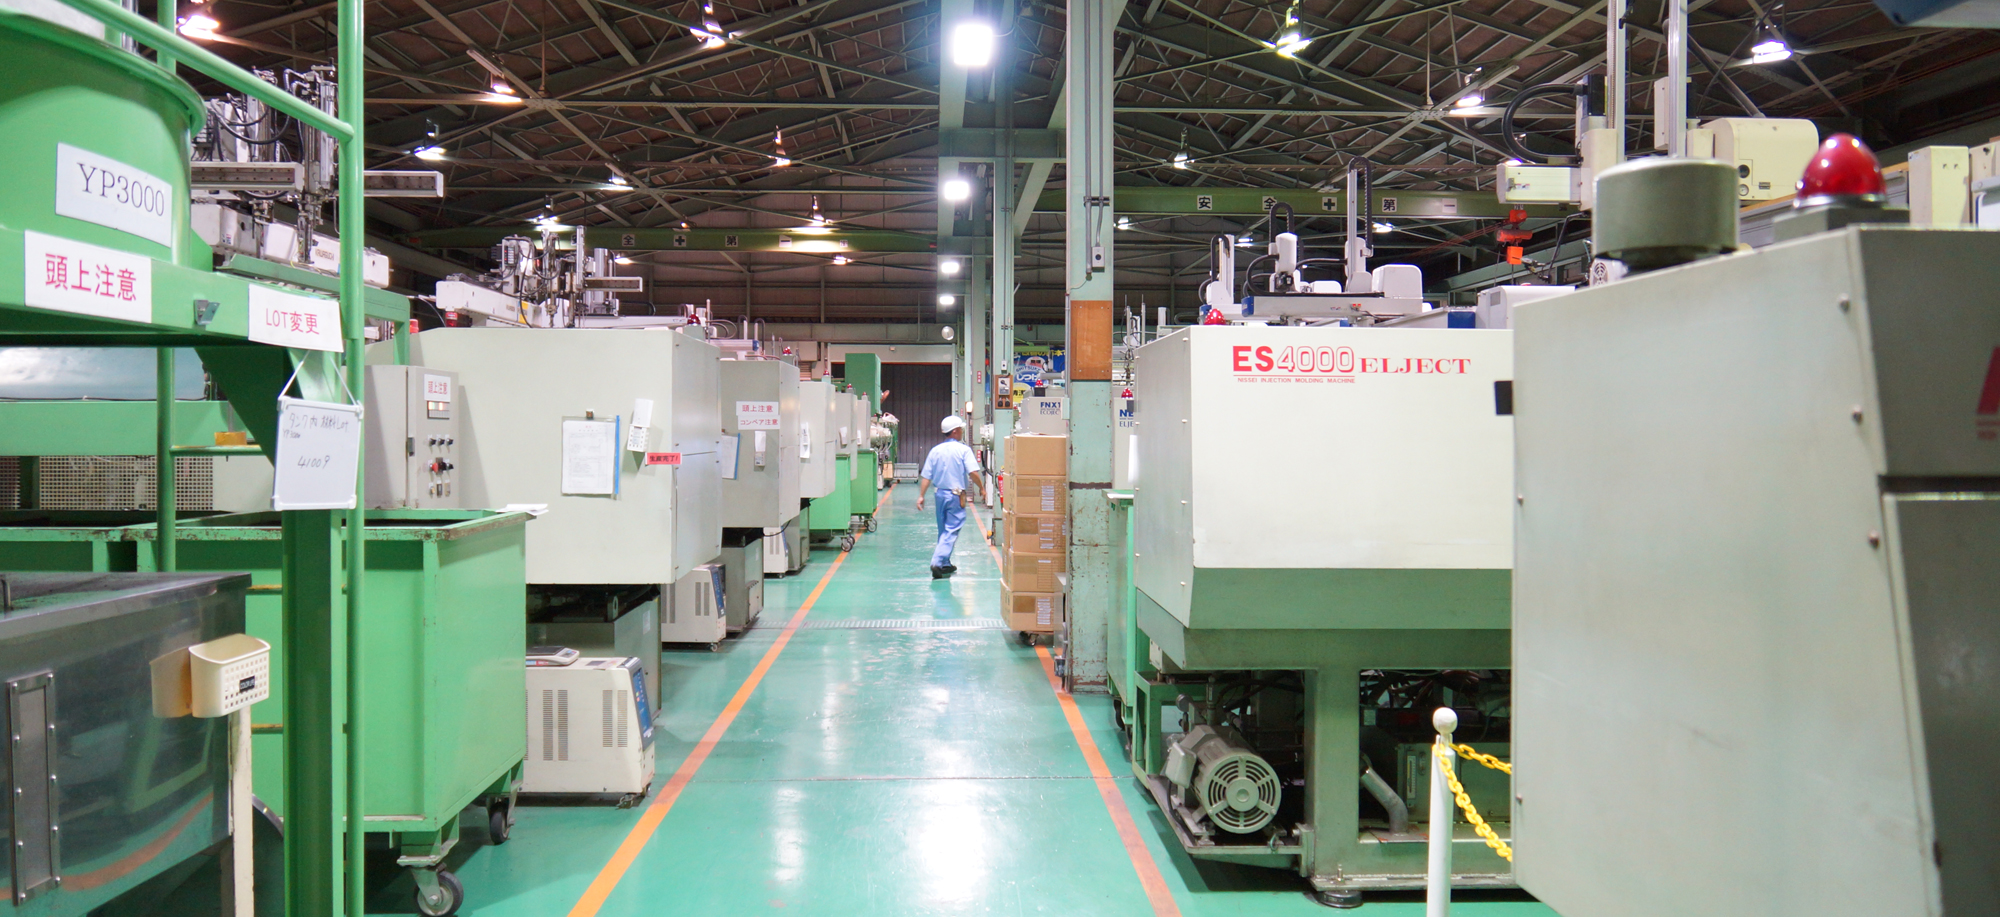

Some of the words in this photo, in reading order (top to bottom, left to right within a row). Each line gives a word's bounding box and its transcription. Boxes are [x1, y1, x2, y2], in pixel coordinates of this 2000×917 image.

[76, 162, 165, 217] YP3000
[45, 253, 137, 302] 頭上注意
[1232, 345, 1355, 373] ES4000
[1358, 357, 1472, 374] ELJECT
[742, 404, 774, 413] 頭上注意
